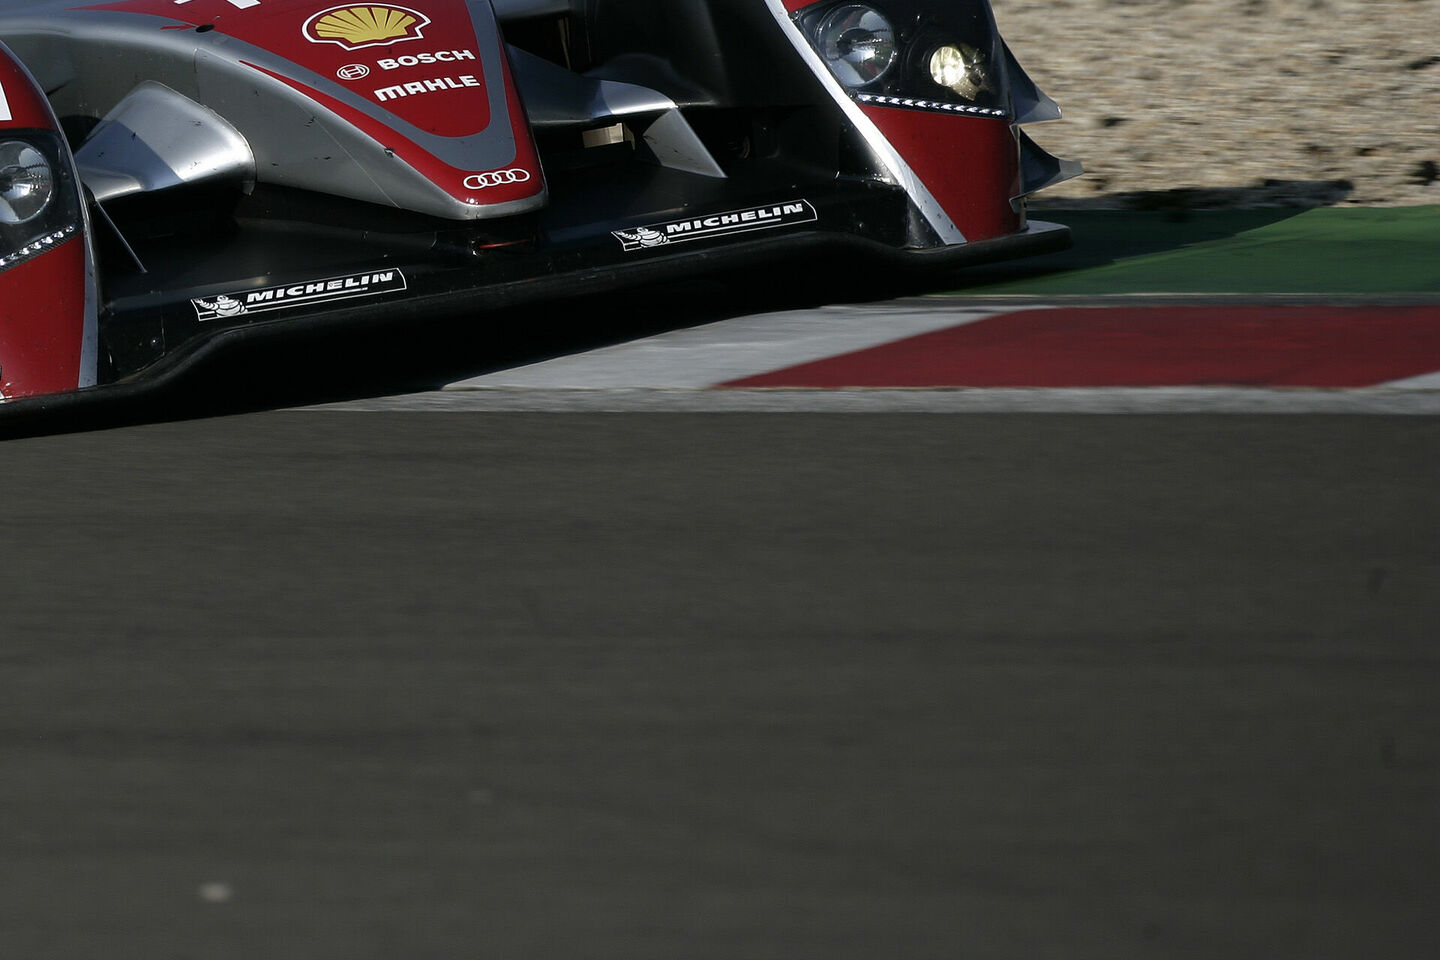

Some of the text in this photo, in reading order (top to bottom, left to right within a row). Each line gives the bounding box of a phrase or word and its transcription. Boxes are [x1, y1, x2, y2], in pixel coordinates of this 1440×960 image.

[377, 49, 477, 71] BOSCH
[373, 75, 481, 102] MAHLE
[666, 202, 804, 234] MICHELIN
[246, 271, 394, 304] MICHELIN
